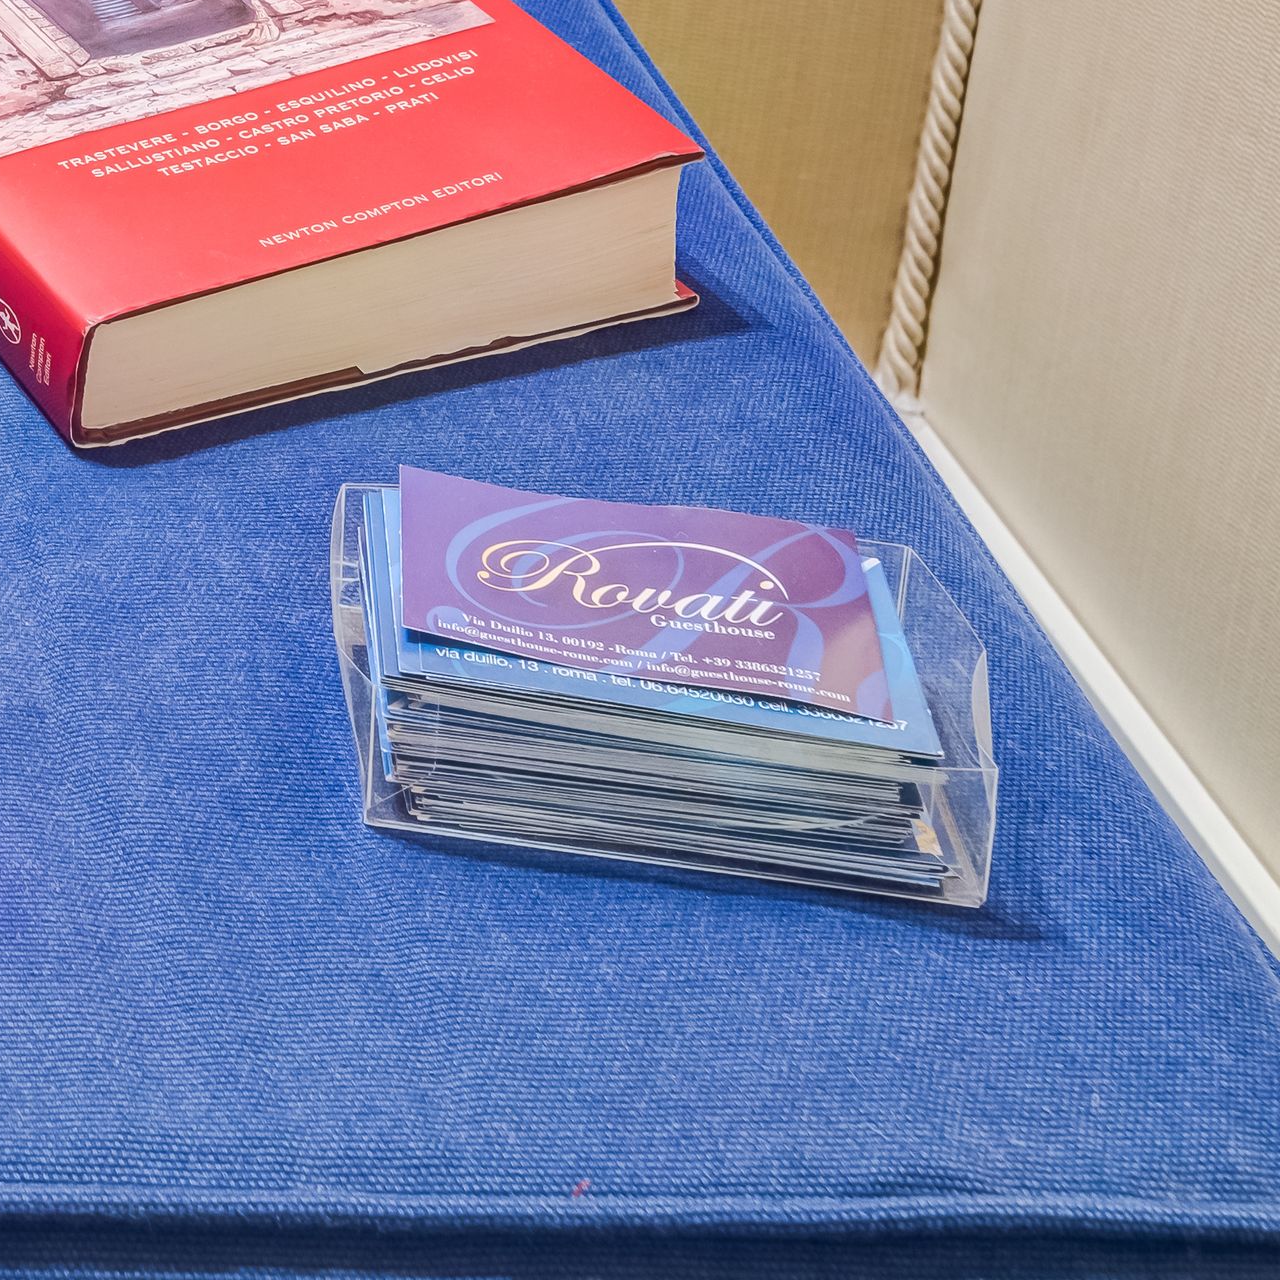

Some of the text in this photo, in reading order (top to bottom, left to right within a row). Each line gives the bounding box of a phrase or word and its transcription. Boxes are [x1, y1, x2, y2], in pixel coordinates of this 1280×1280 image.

[57, 48, 478, 172] TRASTEVERE BORGO ESQUILINO LUDOVISI
[477, 539, 790, 625] Rovati
[462, 613, 486, 628] Via
[490, 618, 534, 638] Duilio
[562, 636, 605, 651] 00192
[702, 656, 731, 667] +39
[735, 658, 821, 682] 3386321257
[650, 613, 775, 641] Guesthouse
